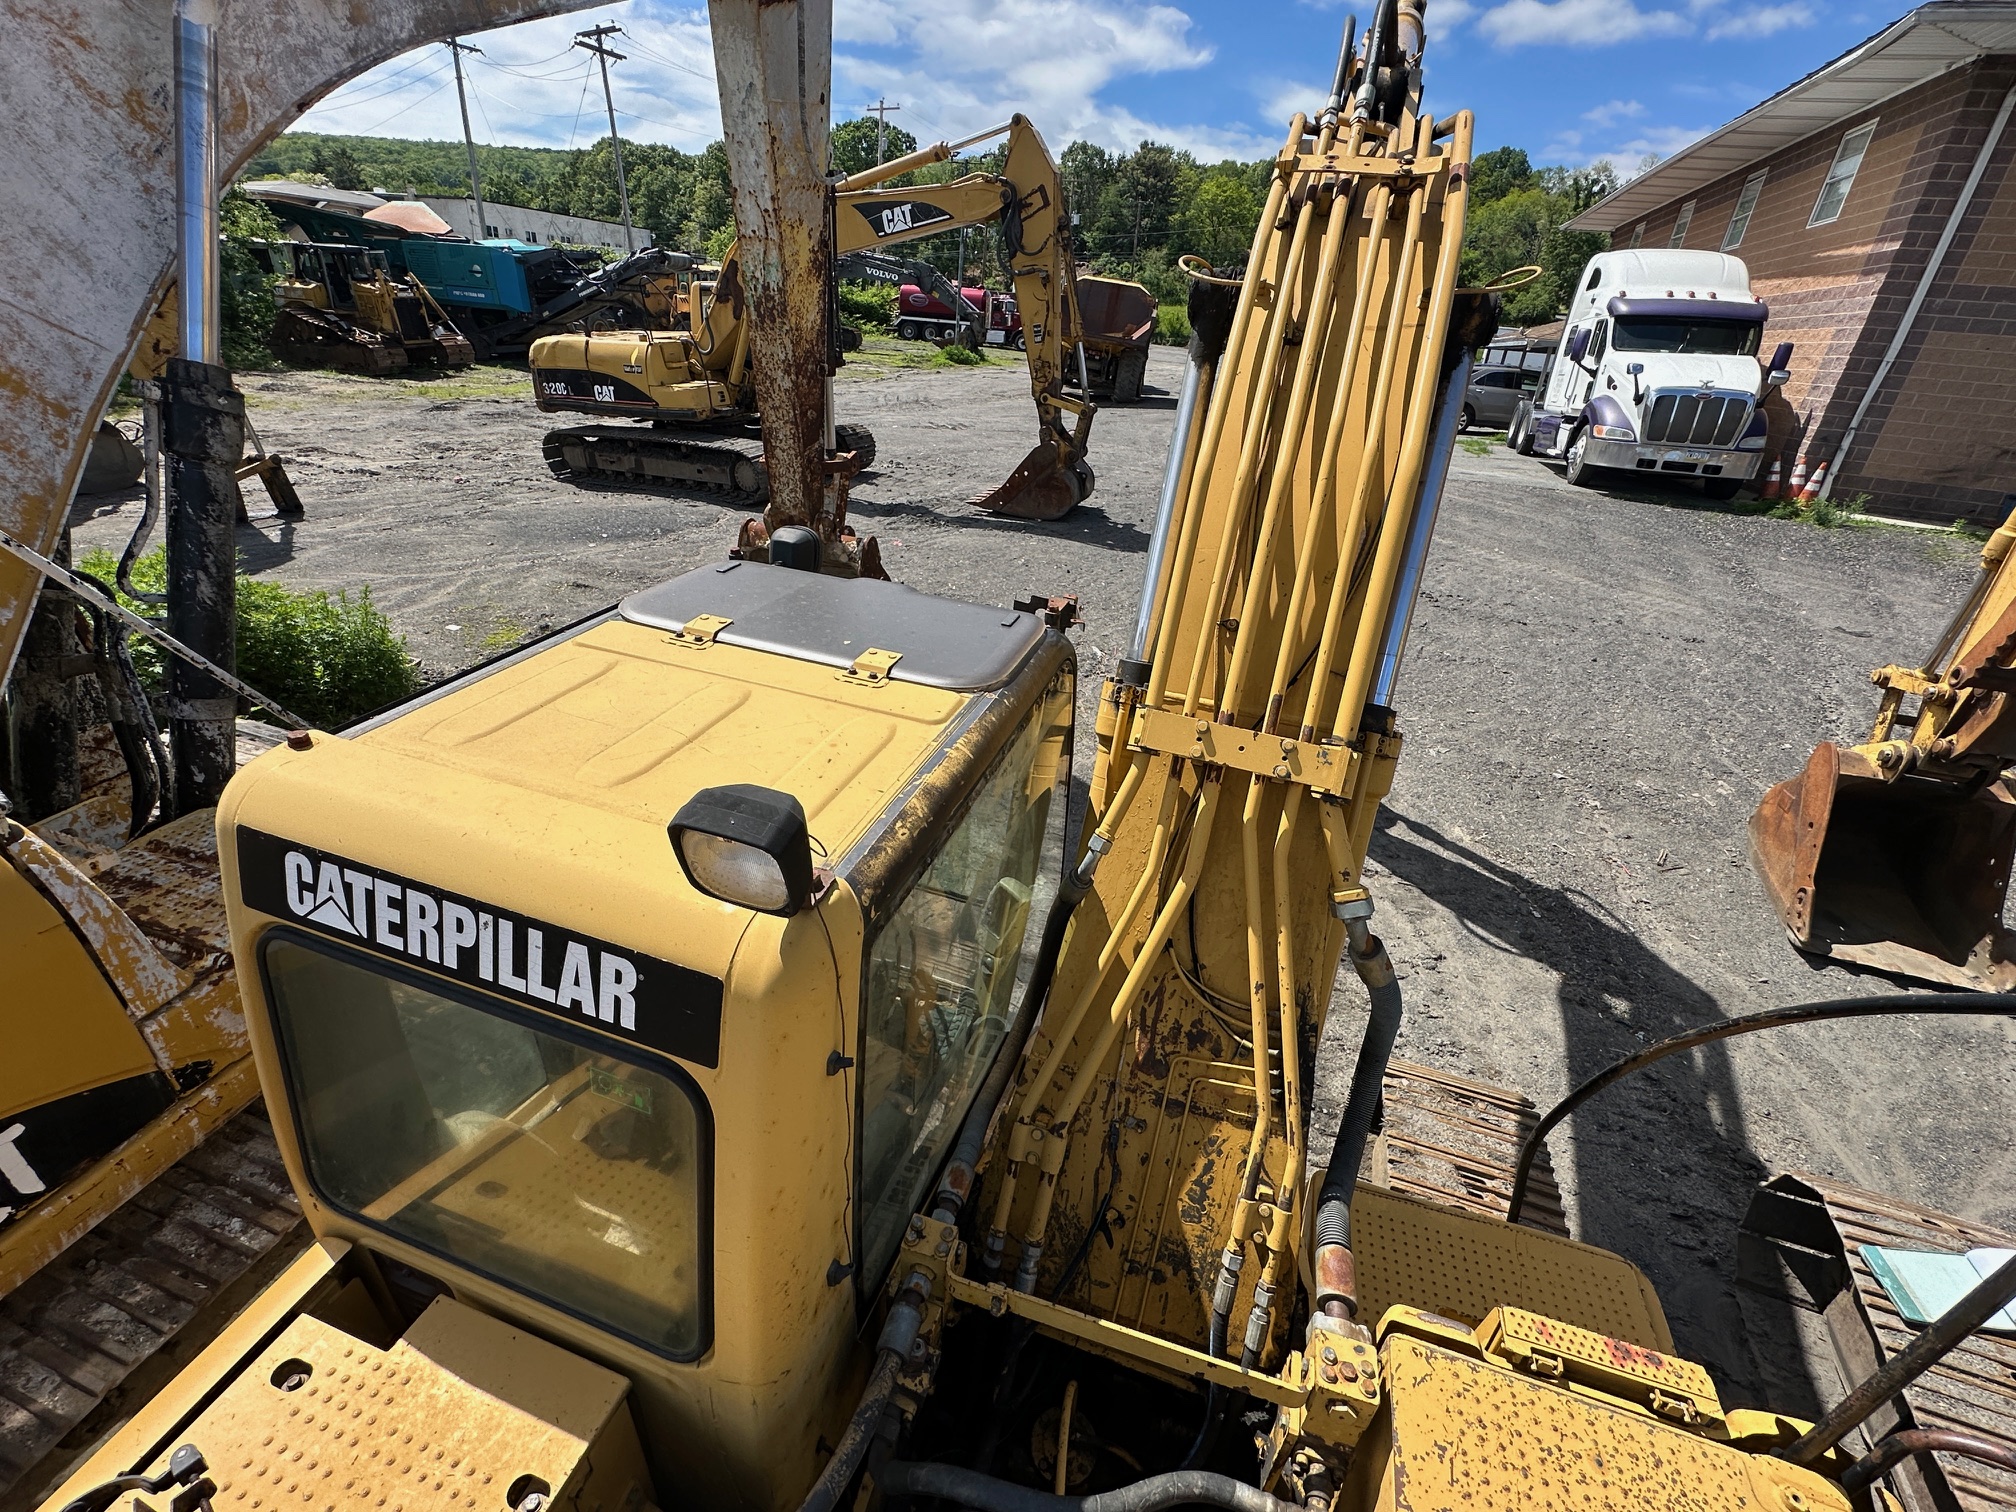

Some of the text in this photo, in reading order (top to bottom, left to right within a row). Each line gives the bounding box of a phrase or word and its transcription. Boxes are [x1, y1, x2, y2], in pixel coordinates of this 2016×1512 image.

[882, 203, 912, 234] CAT
[865, 266, 899, 281] VOLVO
[542, 382, 567, 395] 320C
[594, 384, 615, 402] CAT
[284, 850, 638, 1031] CATERPILLAR
